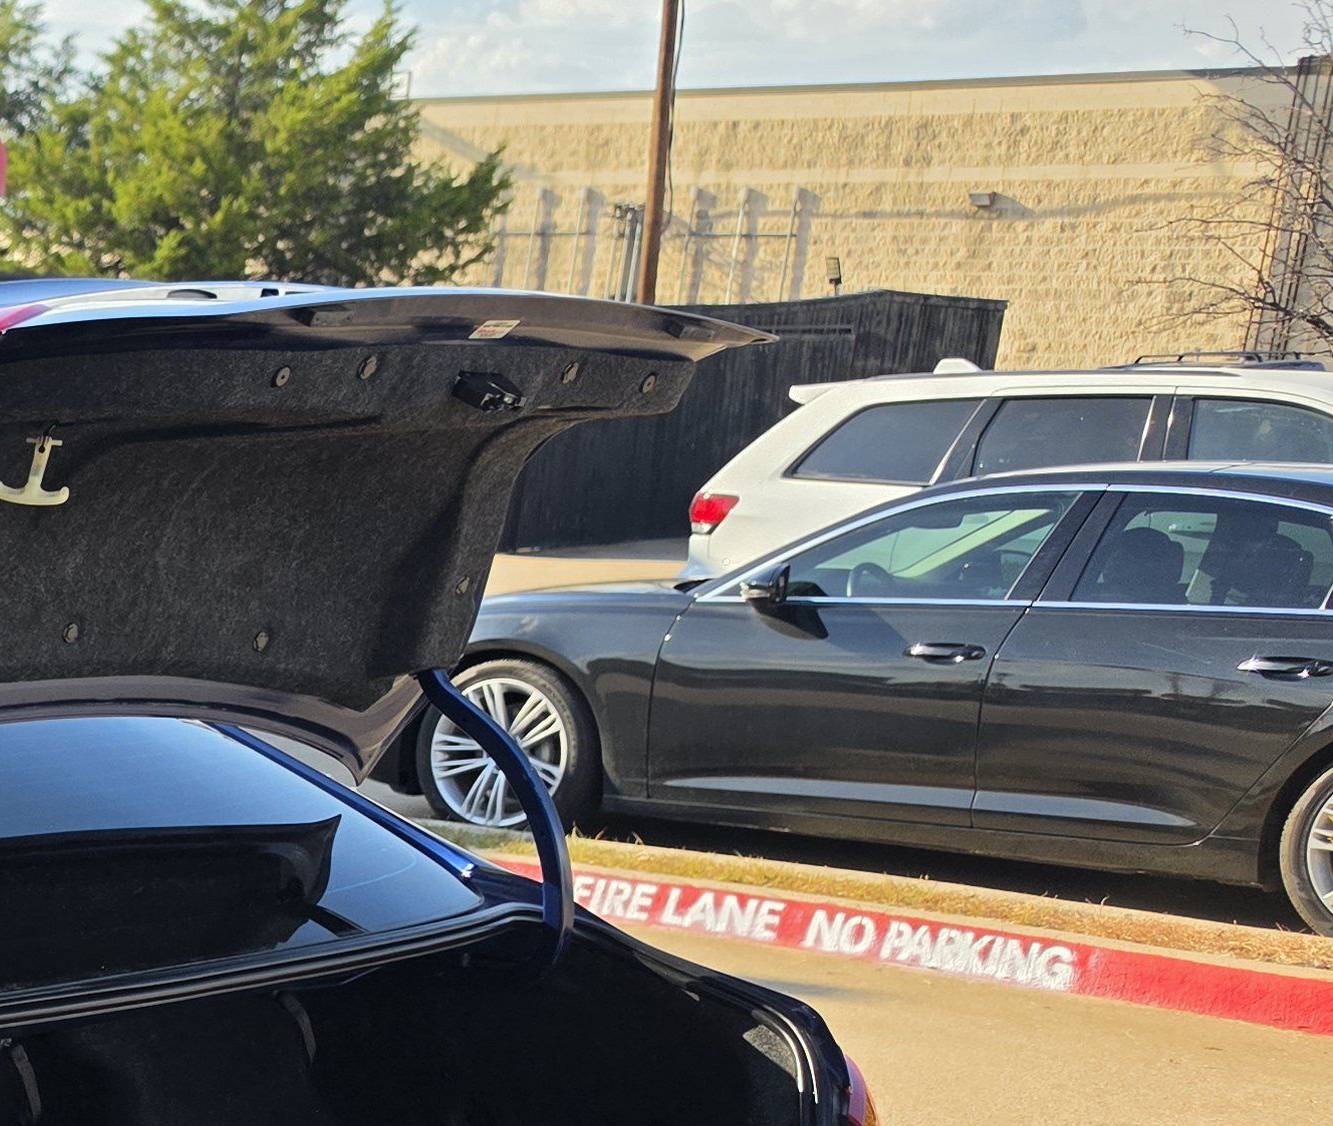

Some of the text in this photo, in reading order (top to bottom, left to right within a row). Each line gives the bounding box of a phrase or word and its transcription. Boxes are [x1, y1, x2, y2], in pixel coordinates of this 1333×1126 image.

[573, 876, 1078, 990] FIRE LANE NO PARKING
